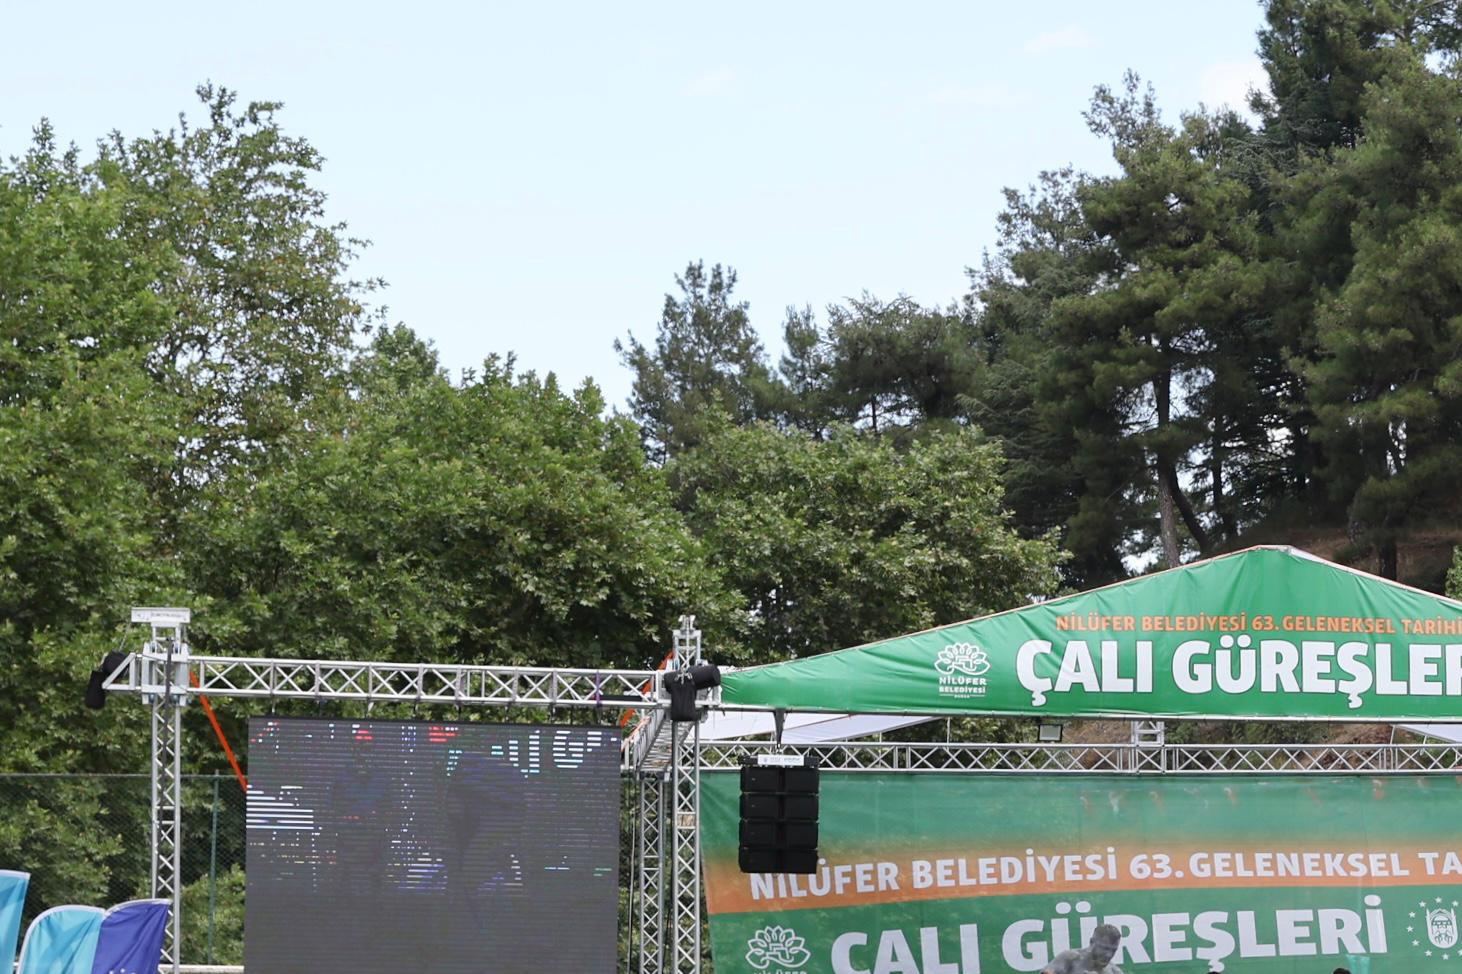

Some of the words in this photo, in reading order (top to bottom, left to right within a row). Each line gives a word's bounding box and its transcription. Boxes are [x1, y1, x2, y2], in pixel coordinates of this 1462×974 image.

[1056, 612, 1136, 631] NİLÜFER
[1141, 611, 1246, 632] BELEDİYESİ
[1402, 616, 1462, 636] TARİHİ
[1016, 639, 1153, 707] ÇALI
[912, 847, 1118, 889] BELEDİYESİ
[1001, 894, 1389, 974] GÜREŞLERİ
